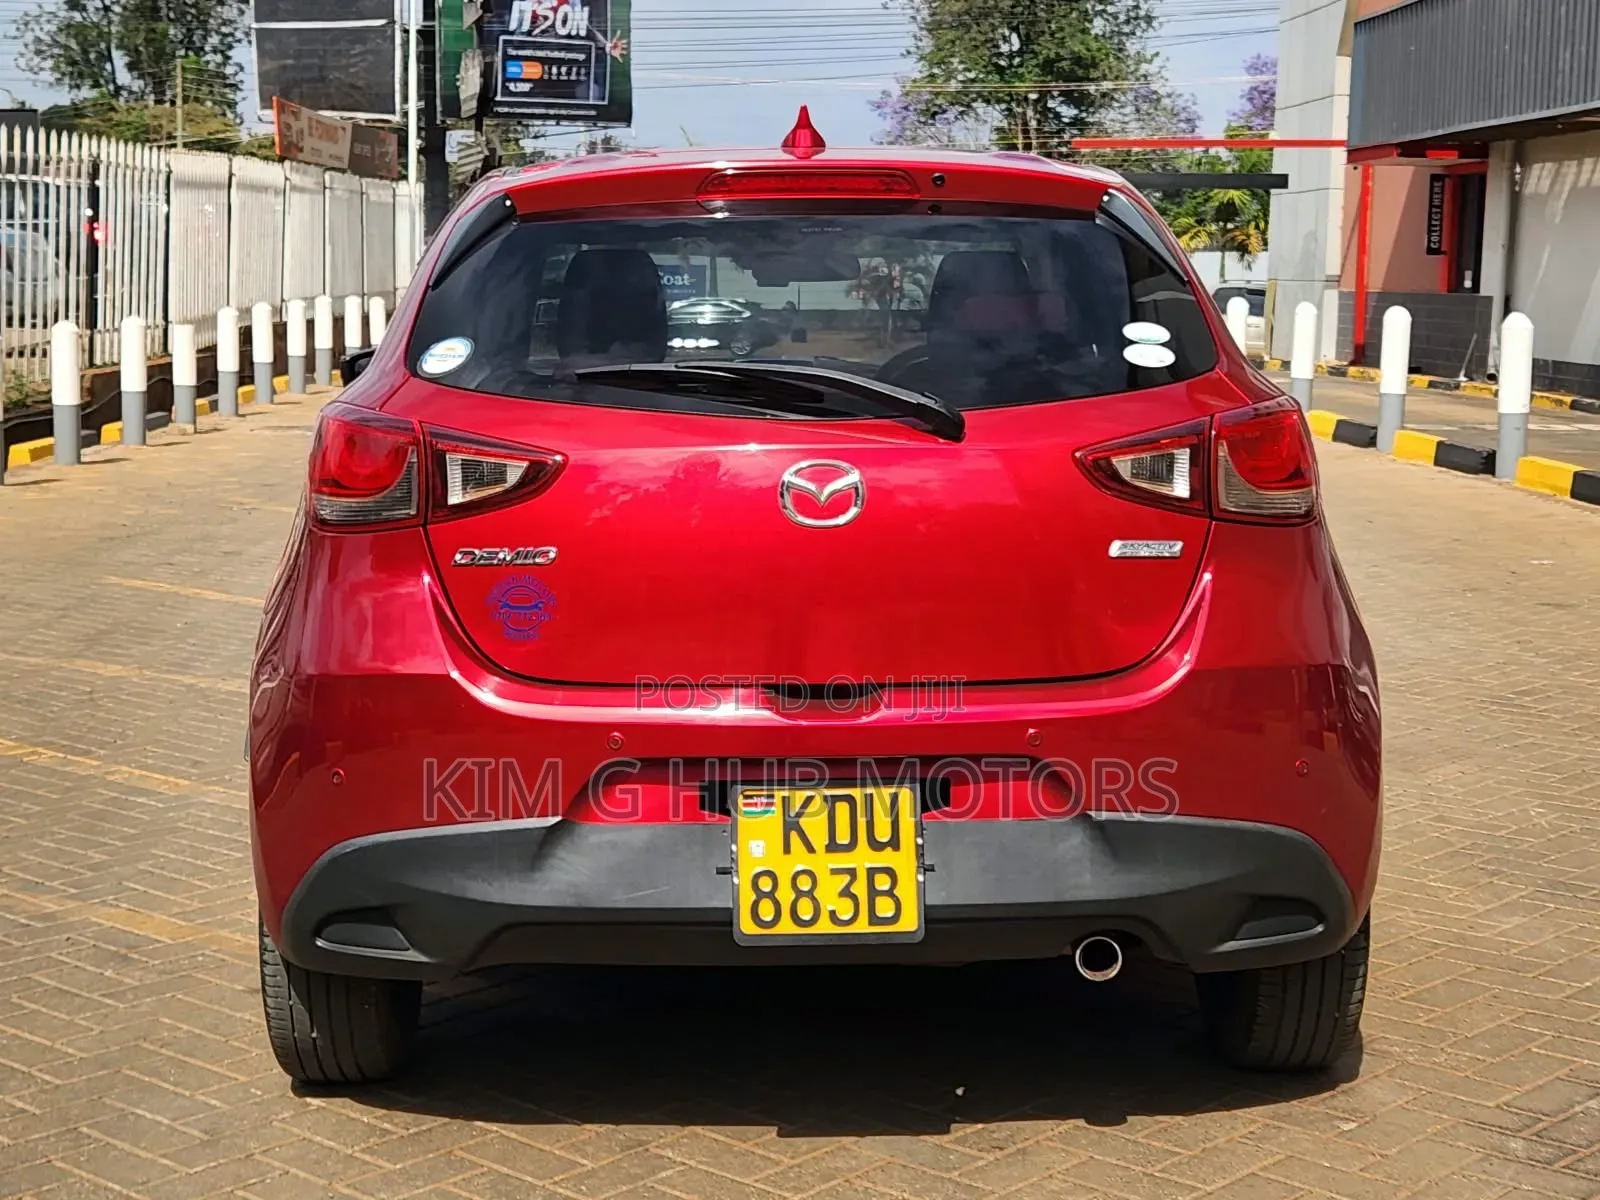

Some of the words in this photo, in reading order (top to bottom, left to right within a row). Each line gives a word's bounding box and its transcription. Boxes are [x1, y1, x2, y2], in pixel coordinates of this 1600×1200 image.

[1430, 207, 1442, 248] COLLECT
[452, 546, 558, 567] DEMIO
[781, 790, 901, 855] KDU
[750, 864, 902, 929] 883B
